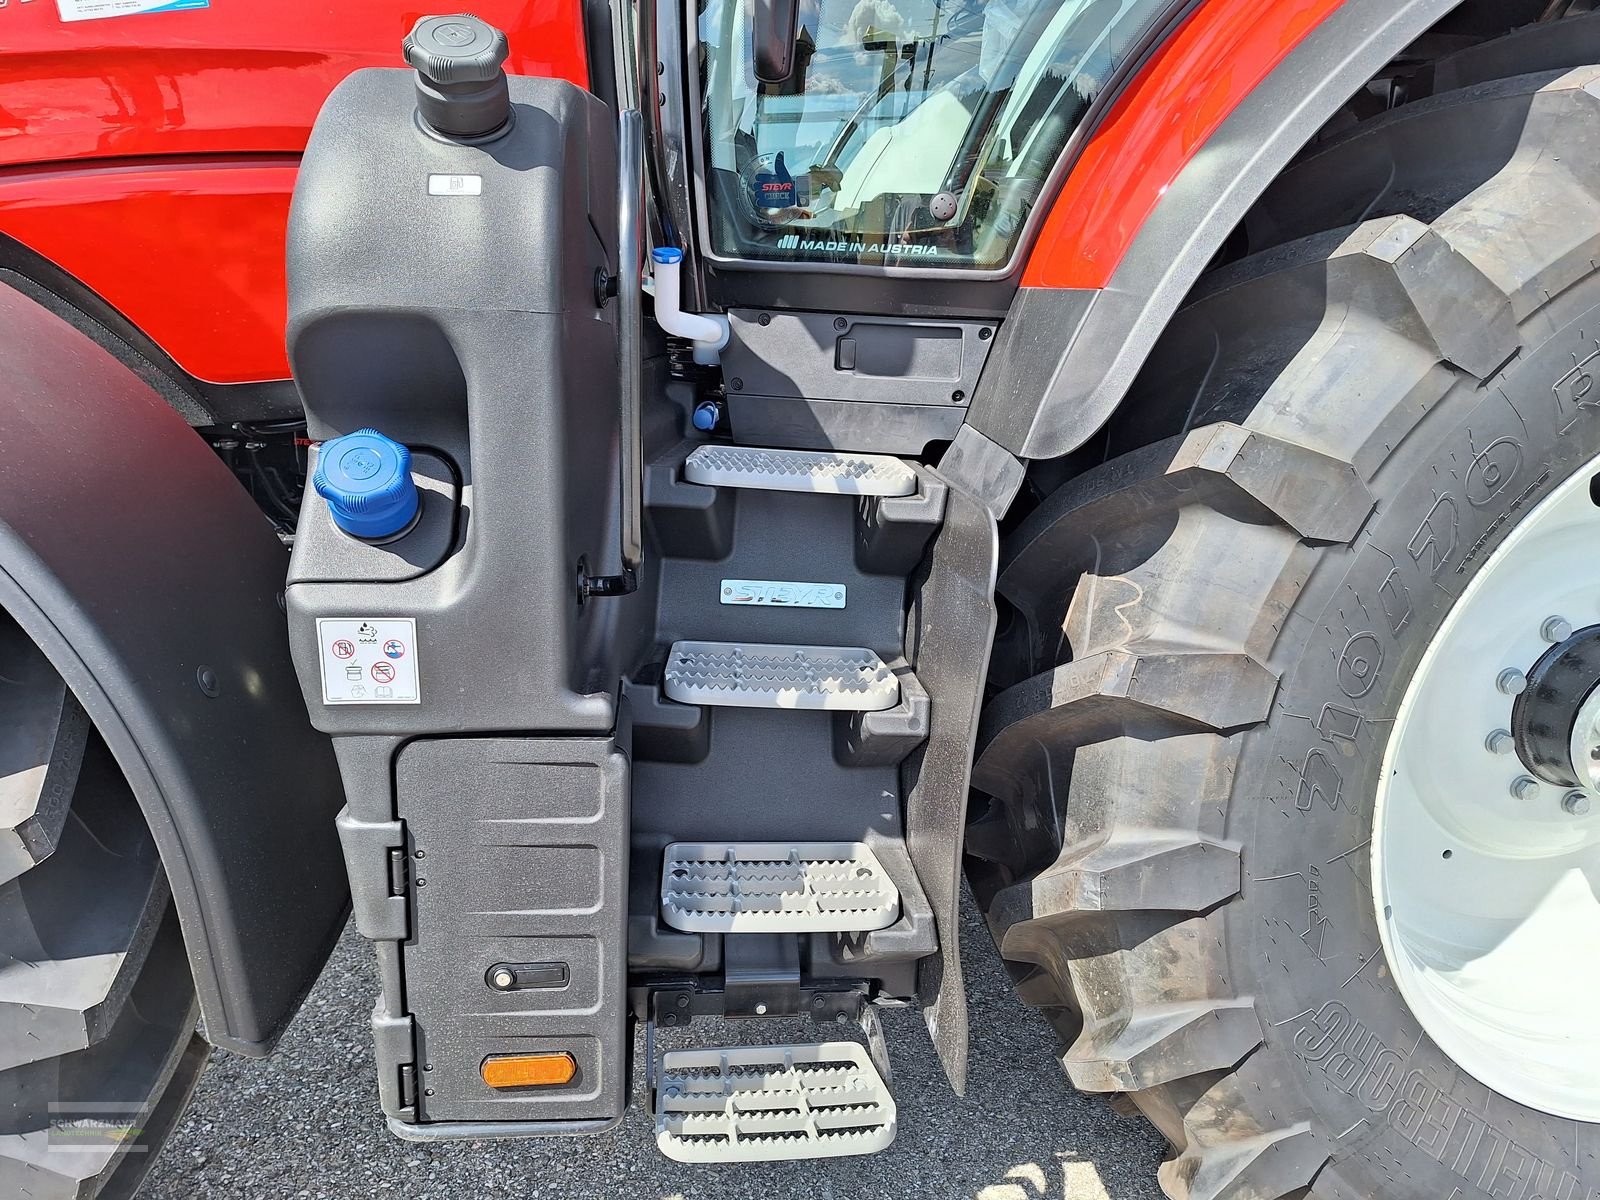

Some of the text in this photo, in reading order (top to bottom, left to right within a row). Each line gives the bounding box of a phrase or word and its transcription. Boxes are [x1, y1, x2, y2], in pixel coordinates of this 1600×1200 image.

[761, 183, 793, 192] STEYR
[800, 240, 938, 256] MADE IN AUSTRIA
[731, 584, 833, 605] STEYR
[1293, 999, 1600, 1200] RELLEBORG
